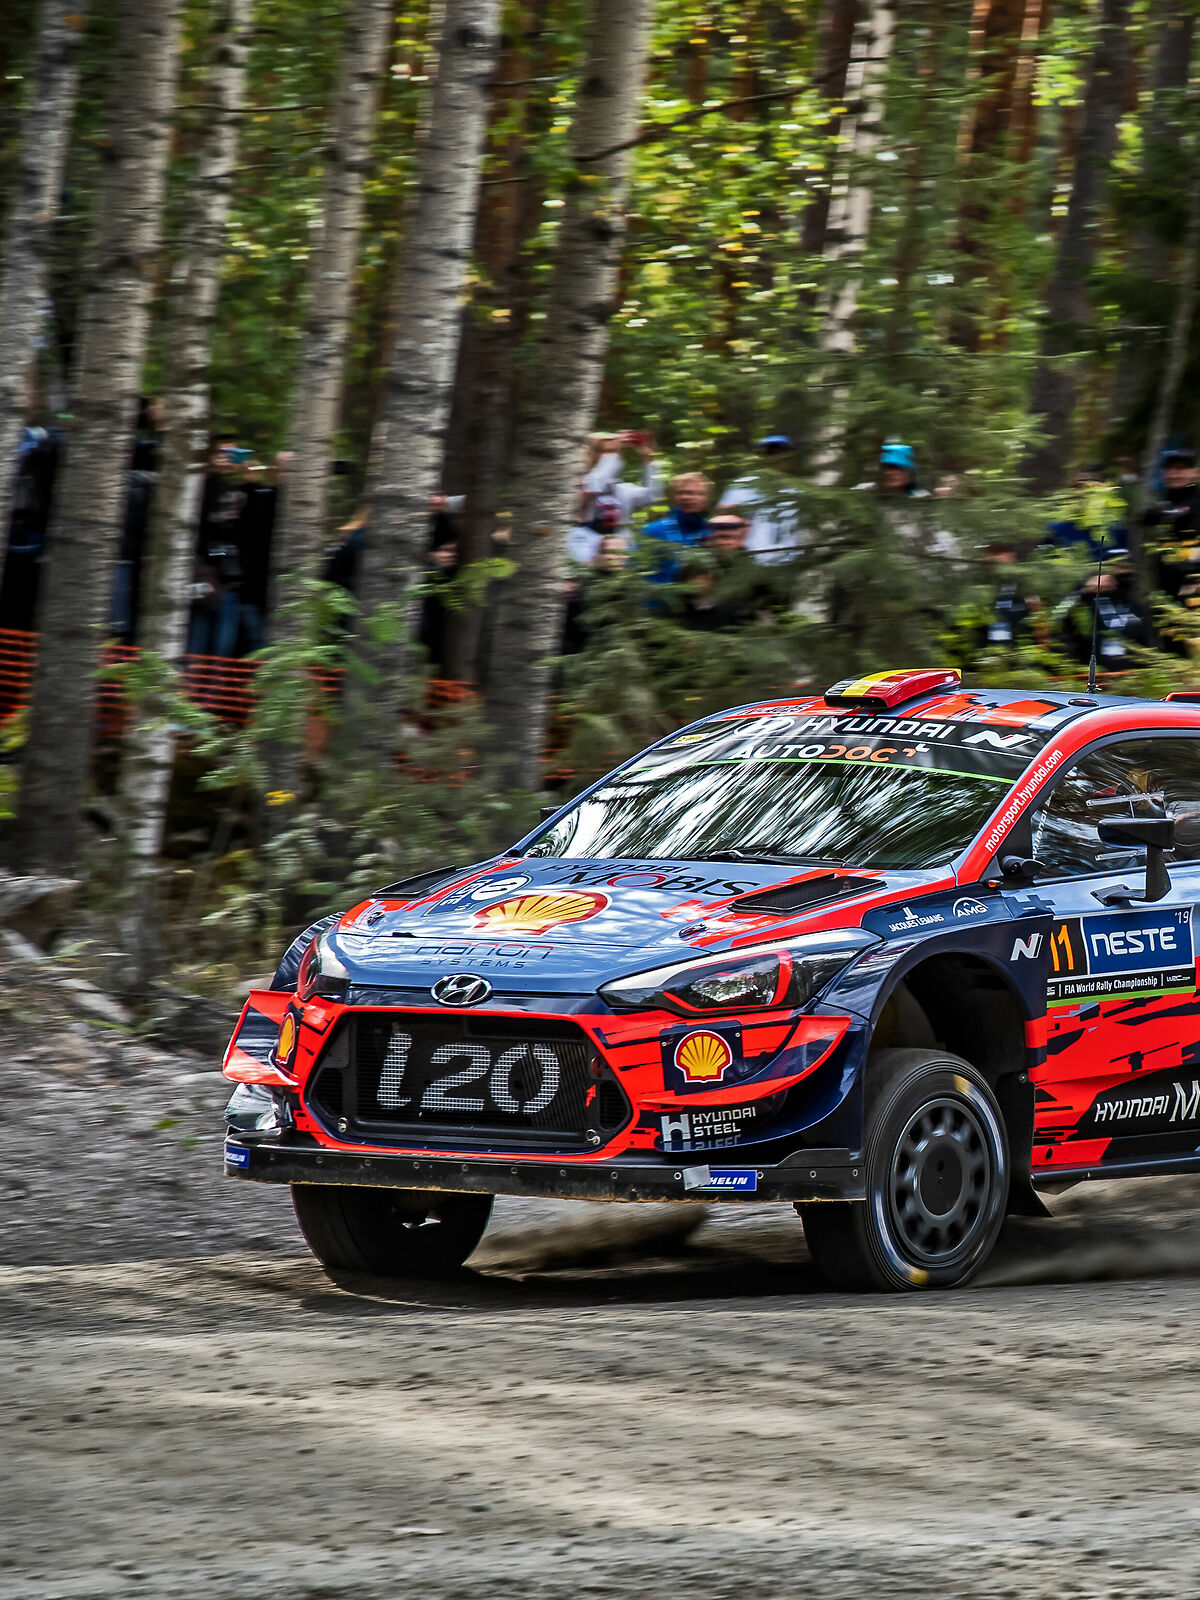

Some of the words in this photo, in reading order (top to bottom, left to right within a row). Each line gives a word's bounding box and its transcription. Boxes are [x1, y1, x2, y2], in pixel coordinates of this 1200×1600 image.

[800, 716, 957, 739] HYUNDAI
[728, 744, 898, 762] AUTODOC
[985, 749, 1064, 852] motorsport.hyundai.com
[541, 863, 691, 873] HYUNDAI
[549, 870, 760, 897] MOBIS
[957, 906, 988, 918] AMG
[1174, 910, 1190, 924] '19
[888, 921, 919, 932] JACQUES
[919, 914, 945, 926] LEMANS
[1090, 926, 1177, 958] NESTE
[422, 958, 526, 969] SYSTEMS
[1064, 984, 1076, 995] FIA
[1076, 981, 1095, 993] World
[1096, 980, 1113, 991] Rally
[1113, 976, 1158, 989] Championship
[692, 1106, 756, 1124] HYUNDAI
[1094, 1095, 1170, 1122] HYUNDAI
[693, 1122, 741, 1137] STEEL
[710, 1176, 749, 1186] HELIN
